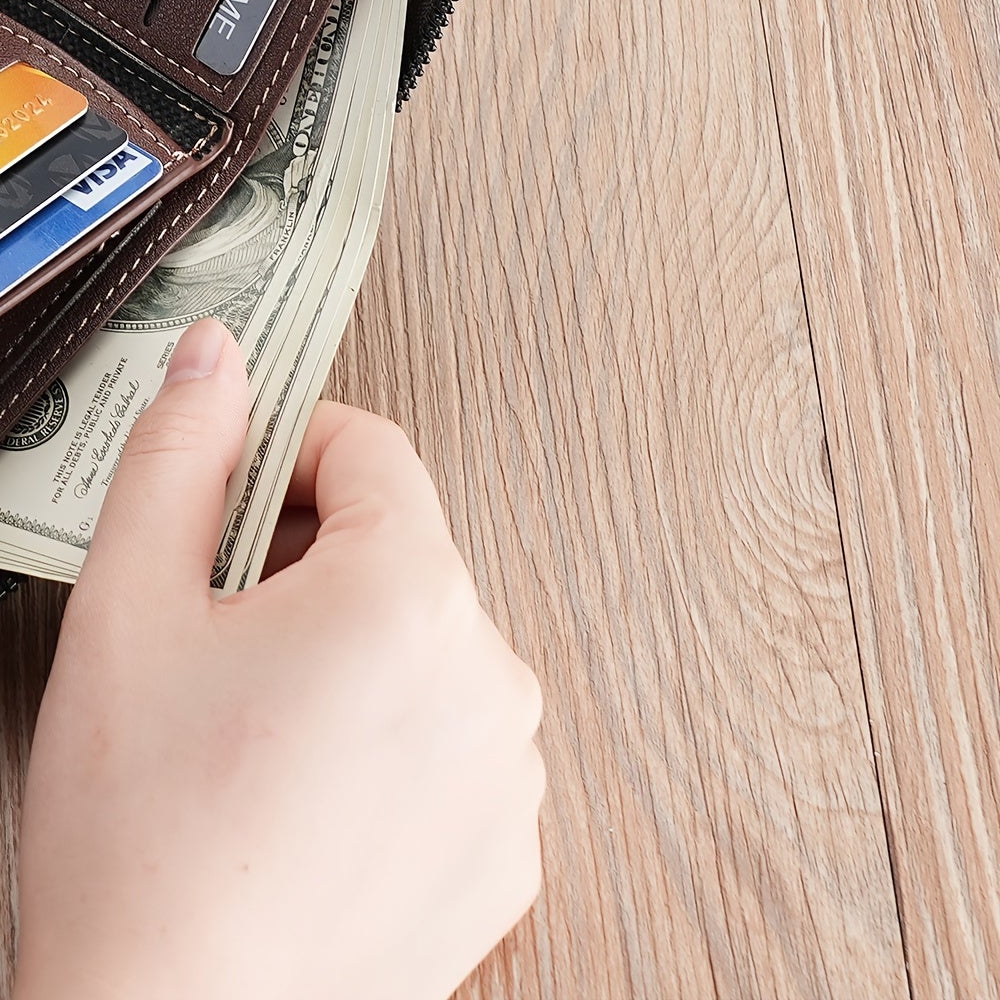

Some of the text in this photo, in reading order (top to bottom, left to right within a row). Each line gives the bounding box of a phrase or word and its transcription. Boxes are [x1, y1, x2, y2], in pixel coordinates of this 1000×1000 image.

[292, 89, 322, 158] ONE
[71, 150, 138, 195] VISA
[269, 211, 295, 261] FRANKLIN
[156, 341, 175, 369] SERIES
[40, 397, 64, 437] RESERVE
[51, 357, 128, 504] FOR ALL DEBTS, PUBLIC AND PRIVATE
[53, 372, 112, 483] THIS NOTE IS LEGAL TENDER
